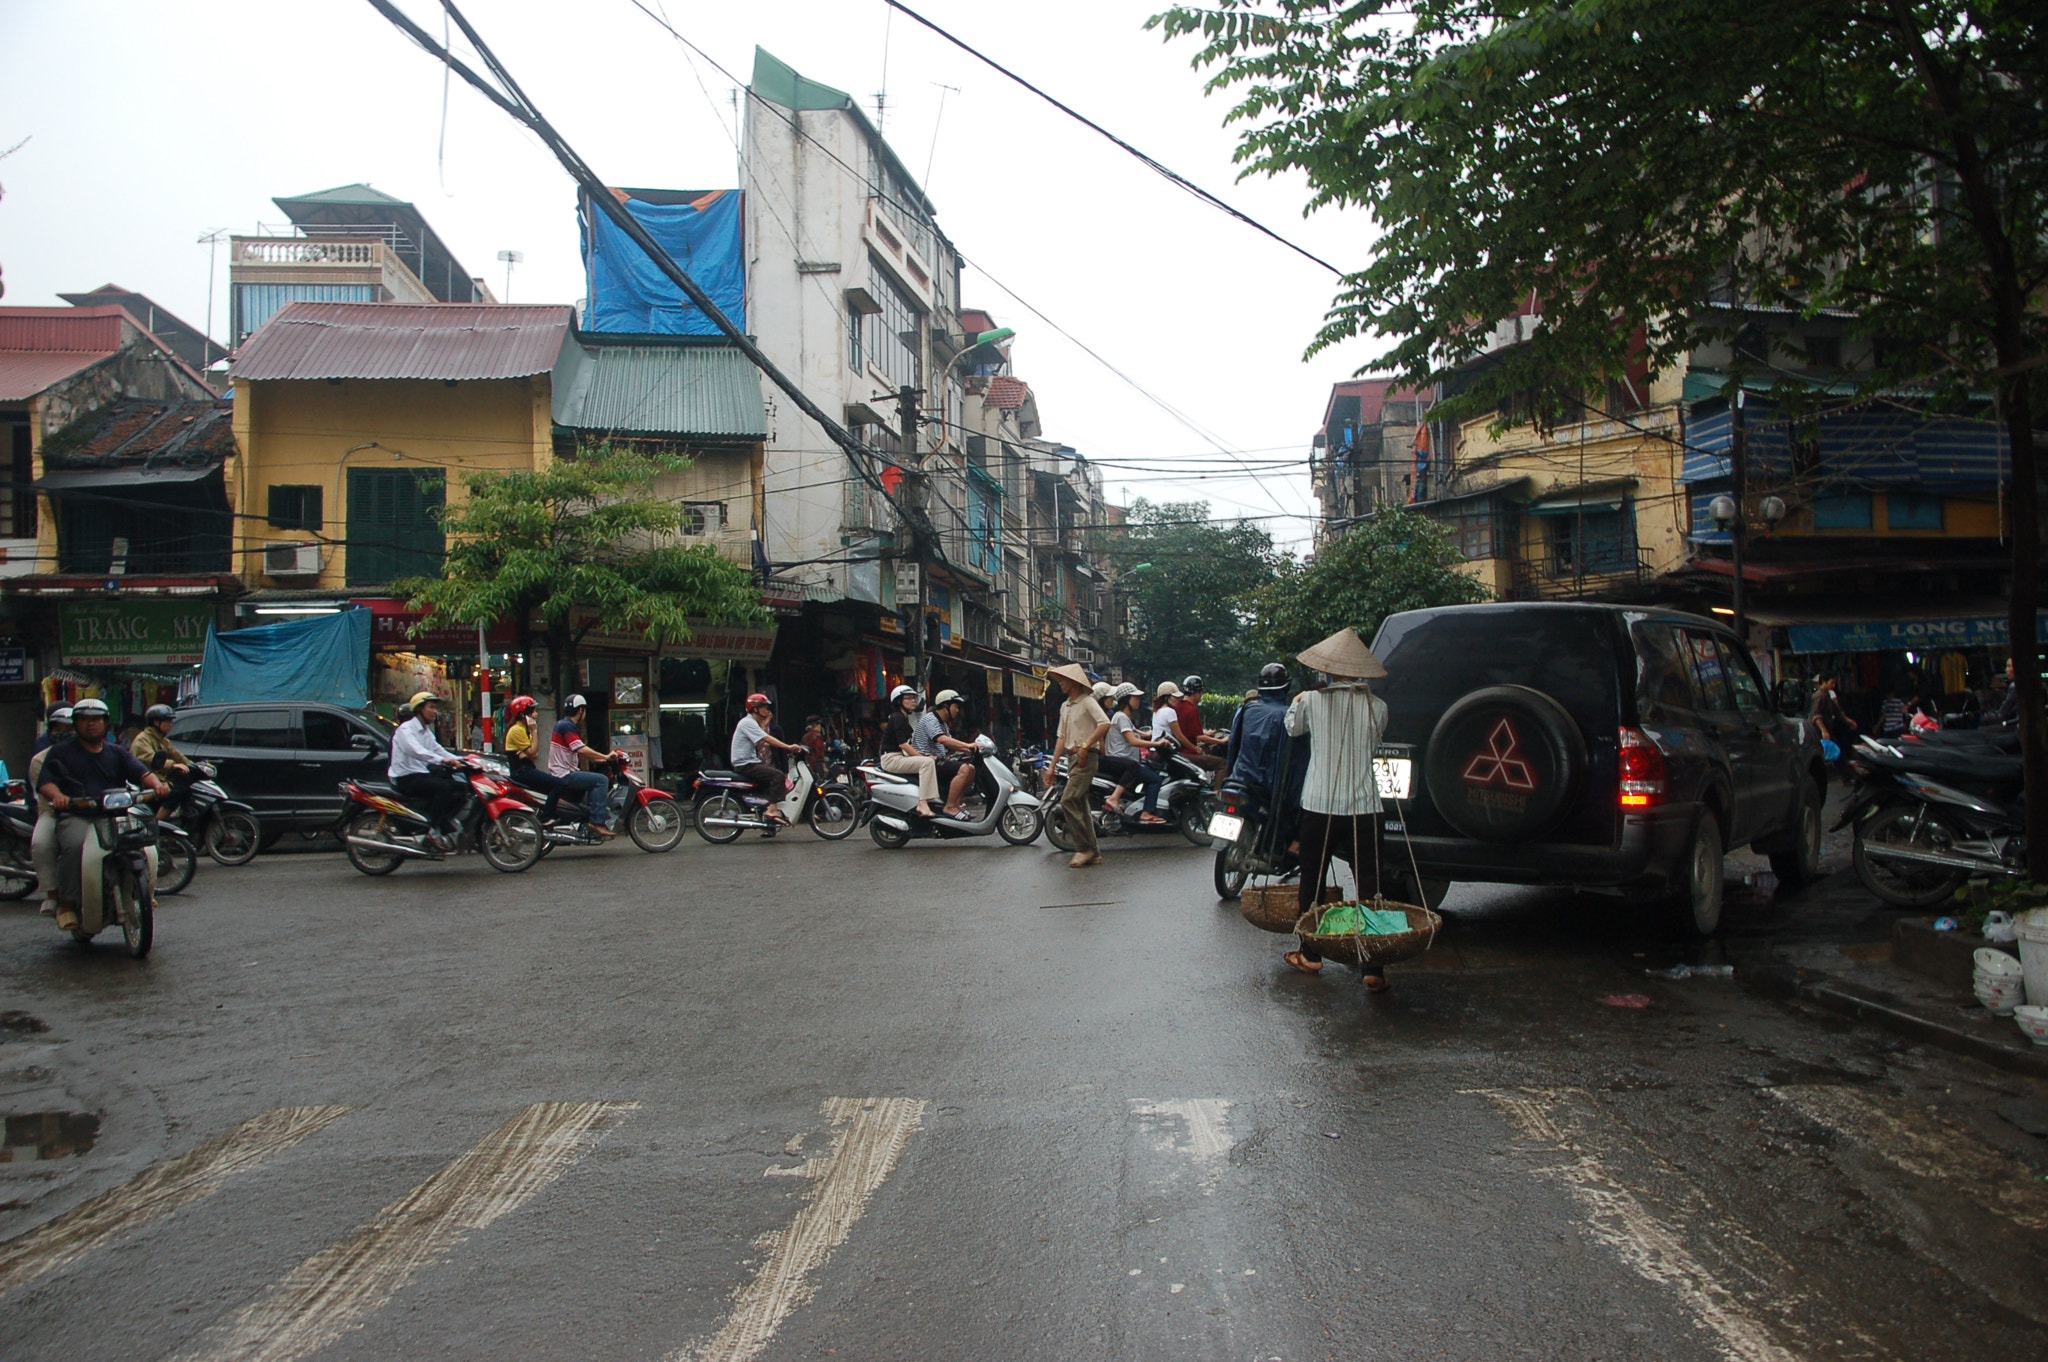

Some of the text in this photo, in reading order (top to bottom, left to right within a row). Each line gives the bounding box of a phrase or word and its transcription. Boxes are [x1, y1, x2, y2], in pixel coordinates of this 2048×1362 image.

[72, 616, 149, 642] TRANG
[1889, 620, 1967, 637] LONG
[1467, 787, 1526, 807] MITSUBISHI
